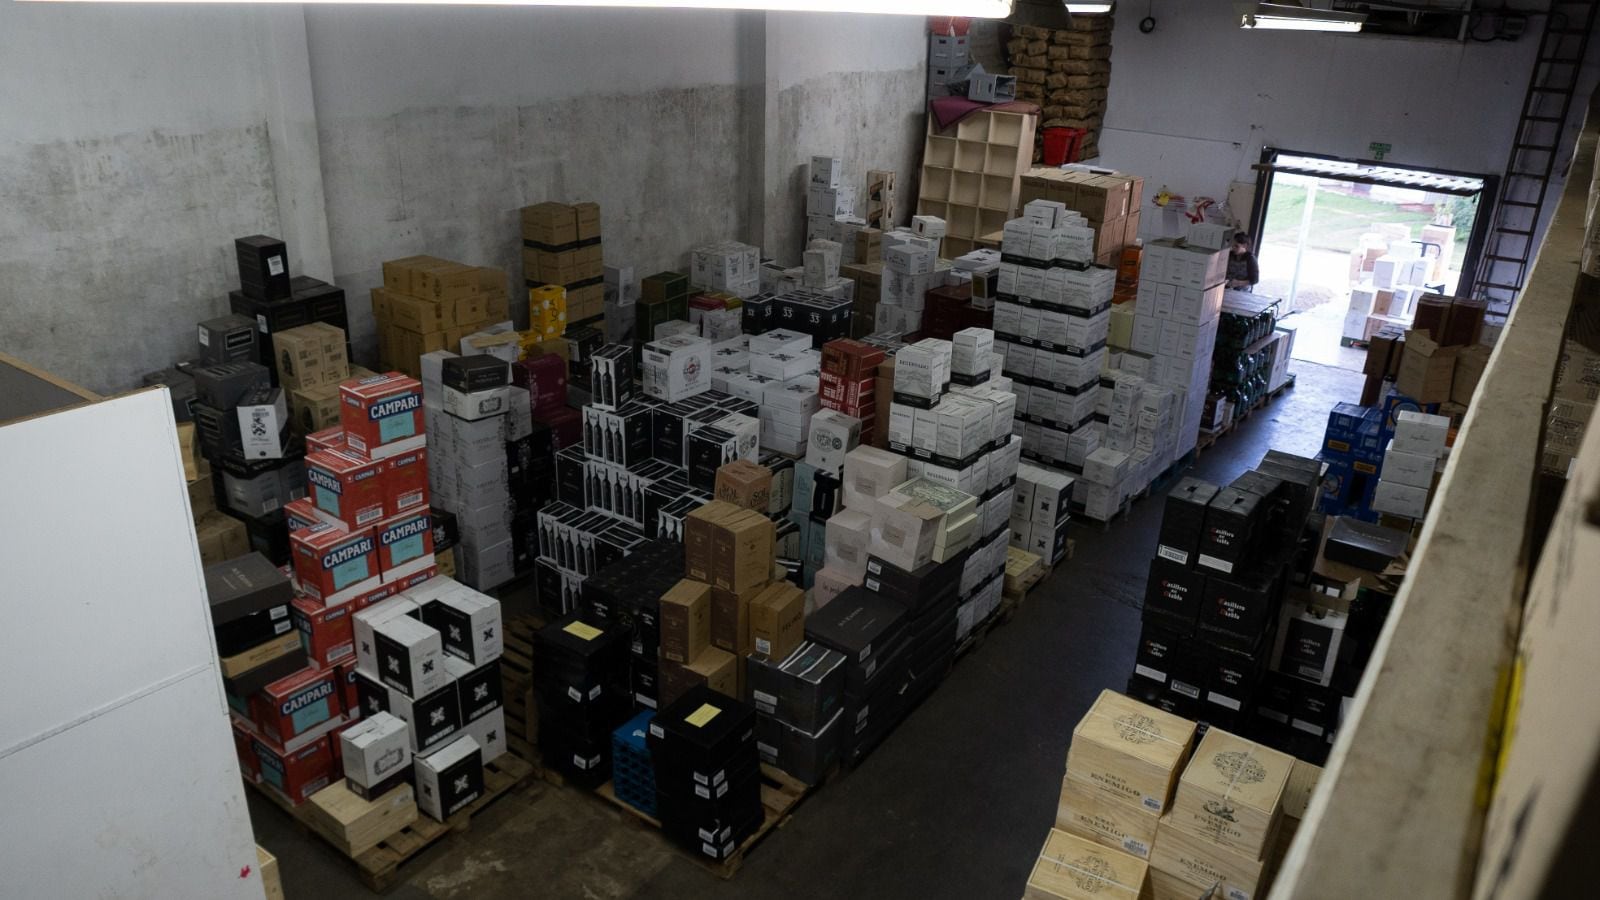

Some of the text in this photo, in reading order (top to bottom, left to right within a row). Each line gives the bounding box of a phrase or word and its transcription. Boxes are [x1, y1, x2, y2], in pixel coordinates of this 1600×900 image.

[783, 308, 793, 318] 33
[810, 314, 820, 324] 33
[370, 395, 419, 419] CAMPARI
[308, 470, 342, 494] CAMPARI
[382, 518, 428, 545] CAMPARI
[323, 540, 371, 569] CAMPARI
[1160, 578, 1188, 593] Casillero
[1217, 596, 1246, 611] Casillero
[1218, 608, 1240, 620] Diablo
[282, 683, 333, 716] CAMPARI
